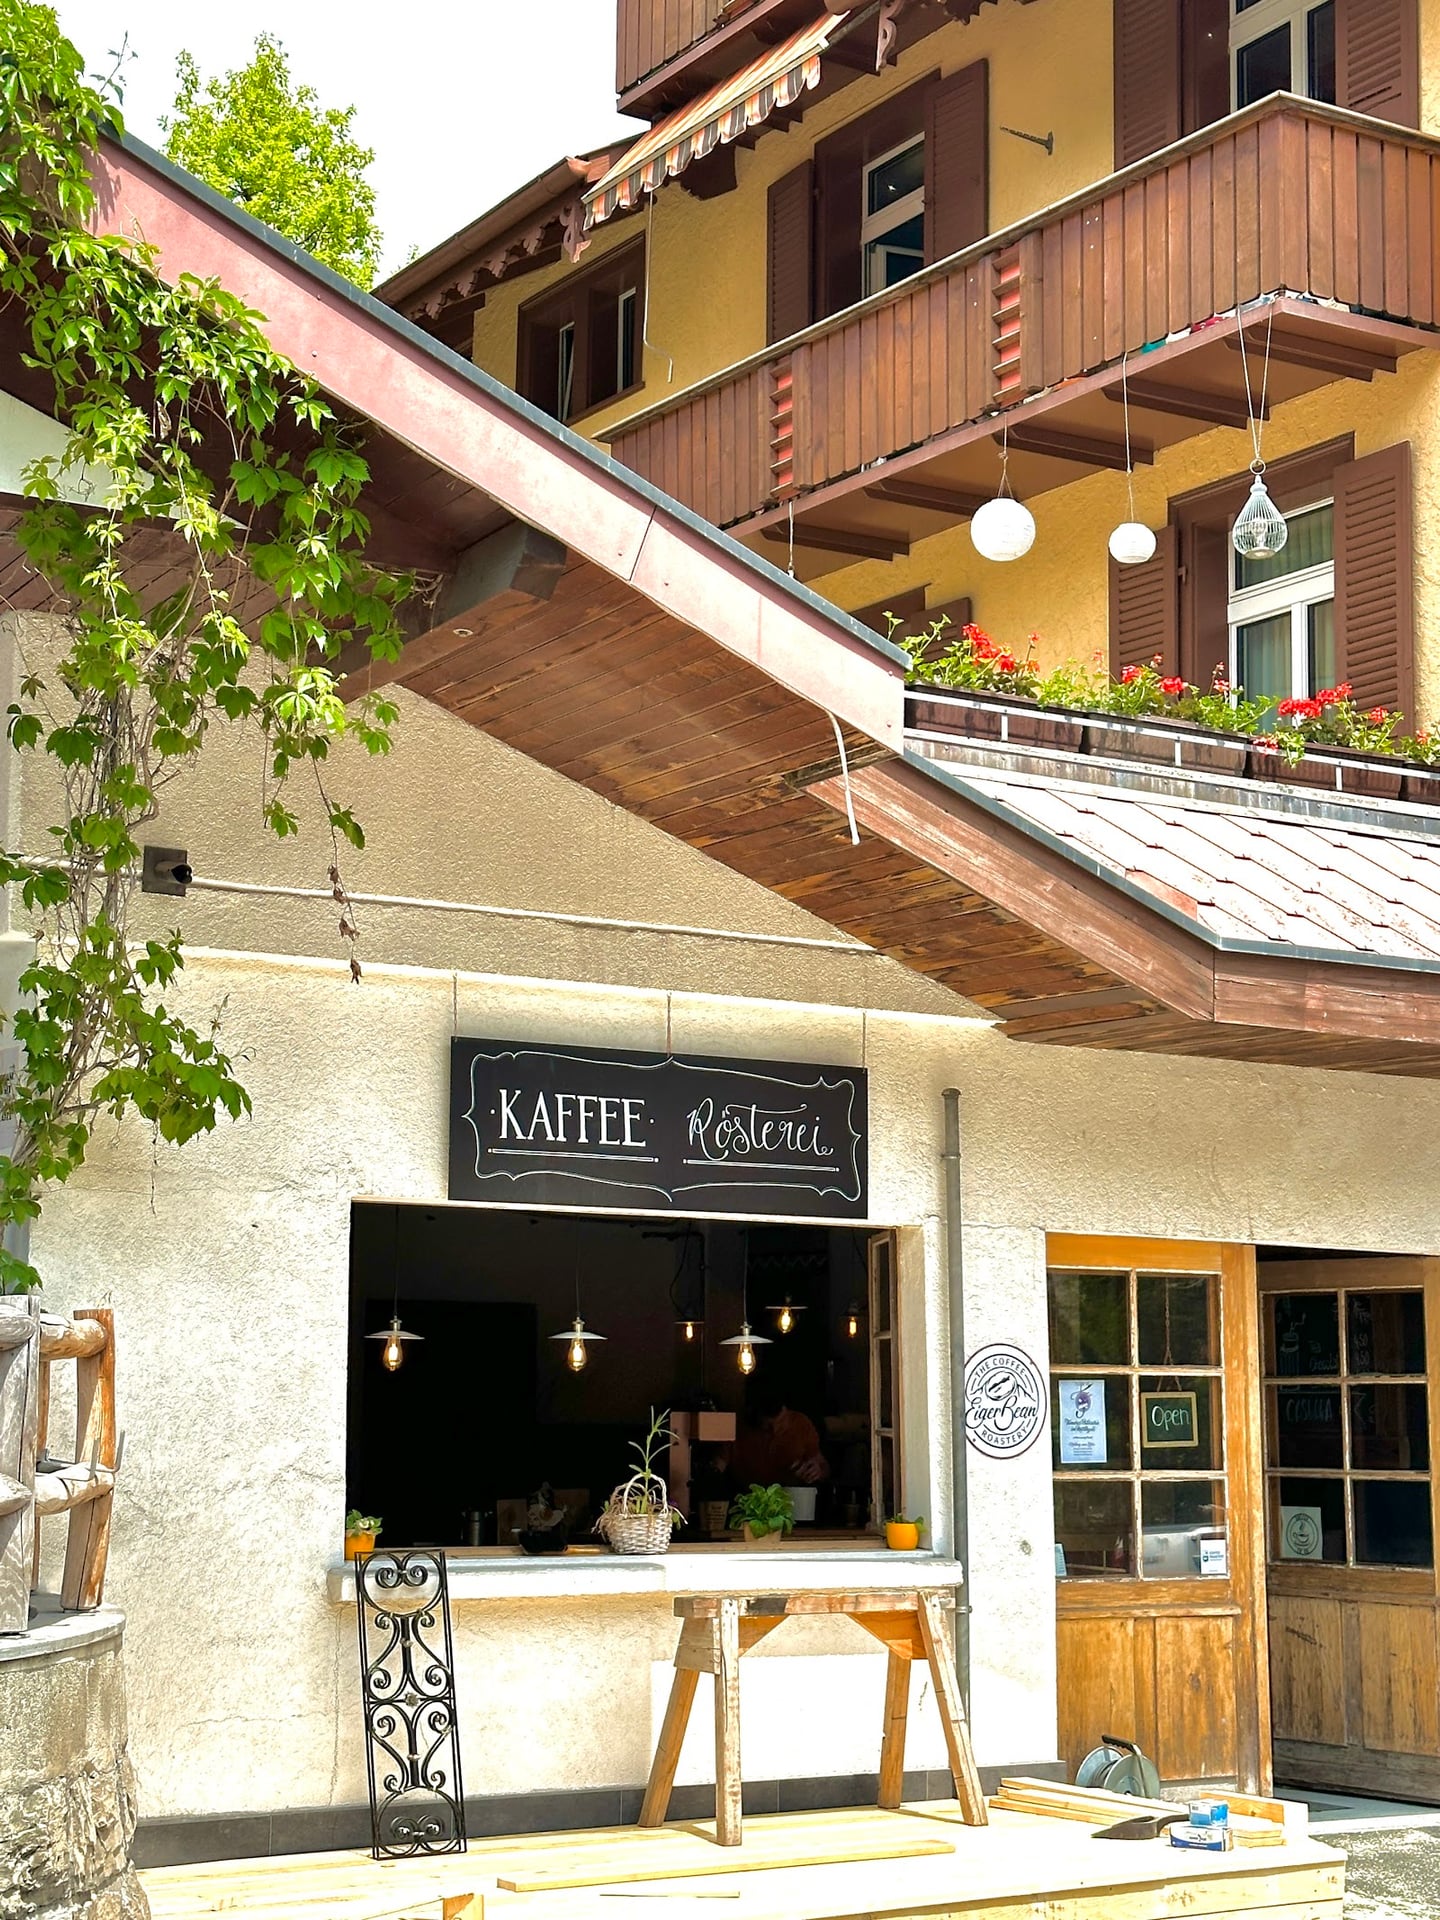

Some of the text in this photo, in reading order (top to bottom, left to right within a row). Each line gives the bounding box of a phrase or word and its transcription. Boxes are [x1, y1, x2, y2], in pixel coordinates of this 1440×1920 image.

[499, 1089, 834, 1161] KAFFEE Rösterei
[974, 1357, 1026, 1378] THE COFFEE
[1151, 1405, 1190, 1431] Open
[981, 1426, 1028, 1445] ROASTERY
